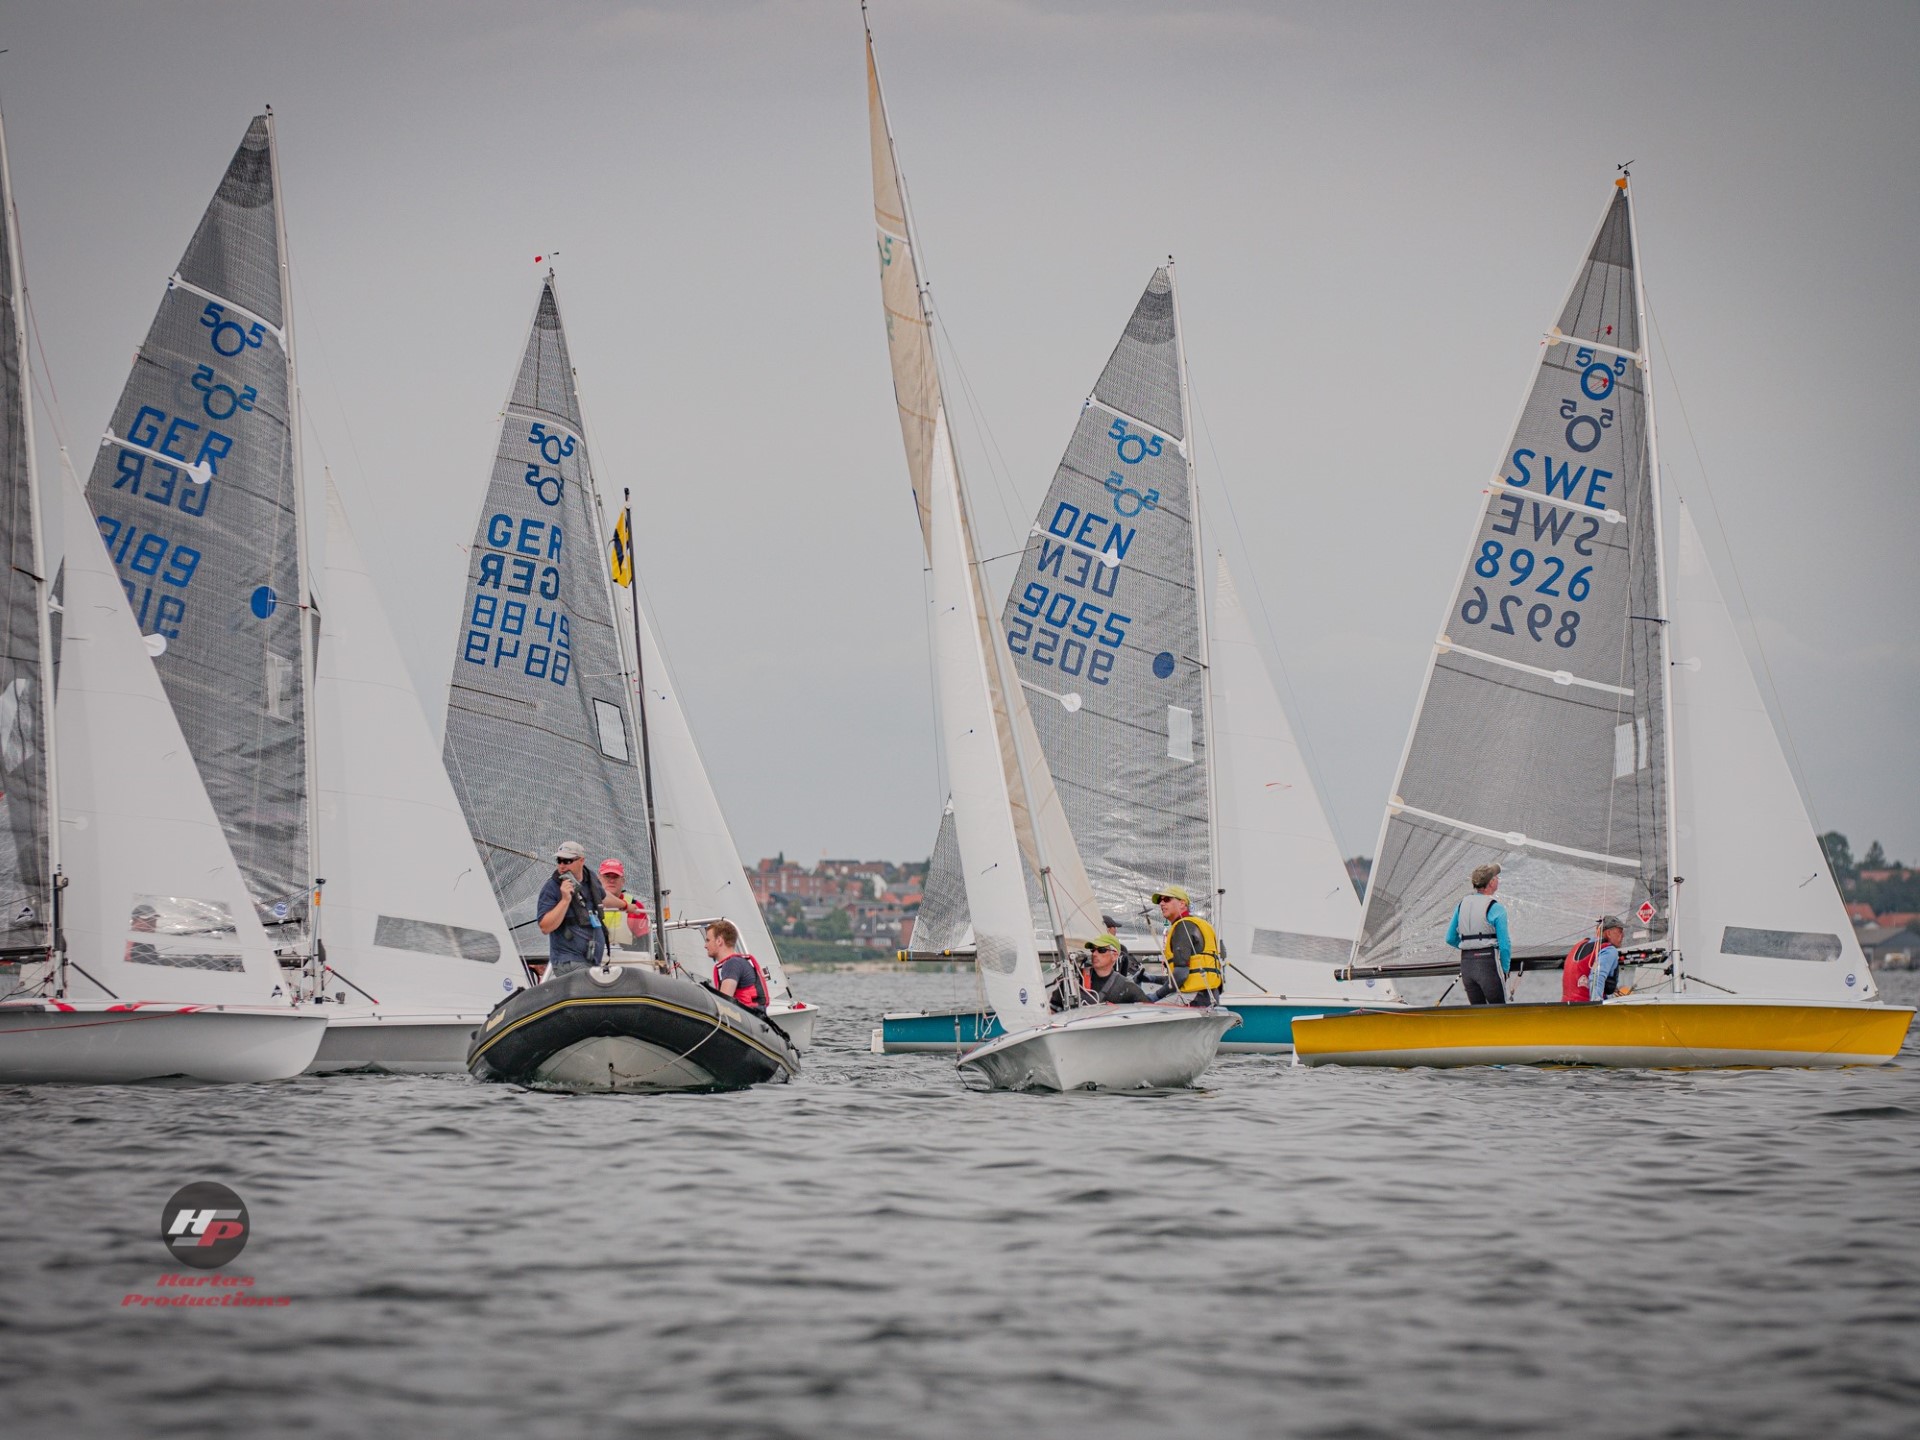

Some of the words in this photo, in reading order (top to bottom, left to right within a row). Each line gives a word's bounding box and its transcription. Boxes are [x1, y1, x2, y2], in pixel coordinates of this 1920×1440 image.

[200, 302, 266, 356] 505
[1576, 346, 1627, 401] 505
[127, 405, 233, 475] GER
[528, 422, 576, 464] 505
[1108, 418, 1164, 464] 505
[1505, 448, 1613, 510] SWE
[487, 513, 563, 564] GER
[1048, 501, 1136, 560] DEN
[1474, 540, 1594, 602] 8926
[471, 593, 570, 650] 8849
[1018, 582, 1132, 649] 9055
